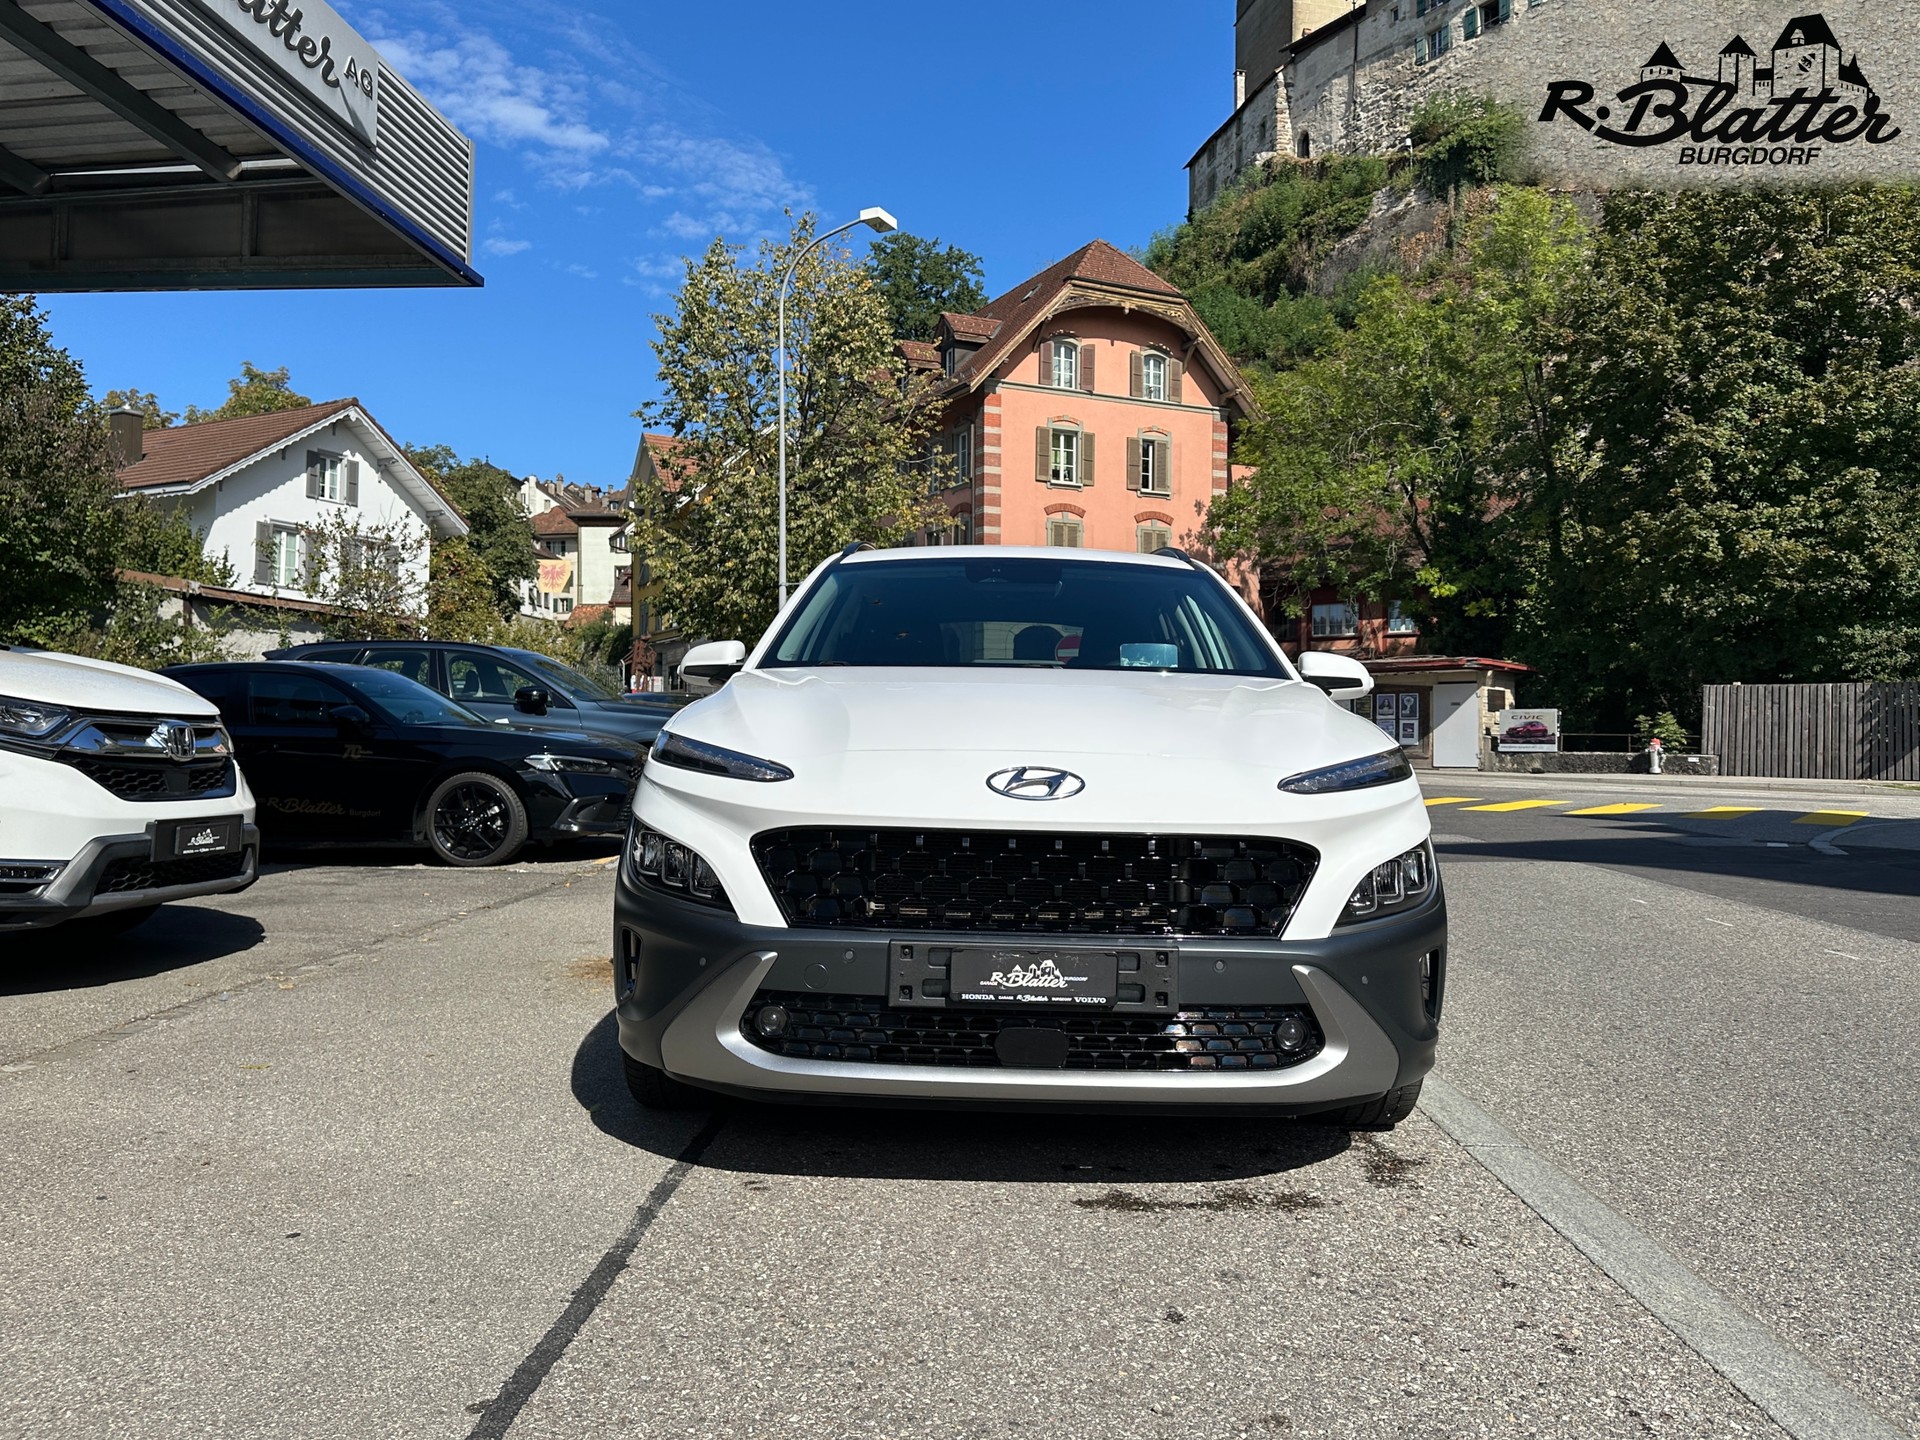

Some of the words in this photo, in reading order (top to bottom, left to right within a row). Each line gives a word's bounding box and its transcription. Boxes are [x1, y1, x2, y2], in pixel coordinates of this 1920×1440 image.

[344, 56, 373, 100] AG
[349, 808, 381, 818] Burgdorf
[1073, 996, 1107, 1004] VOLVO
